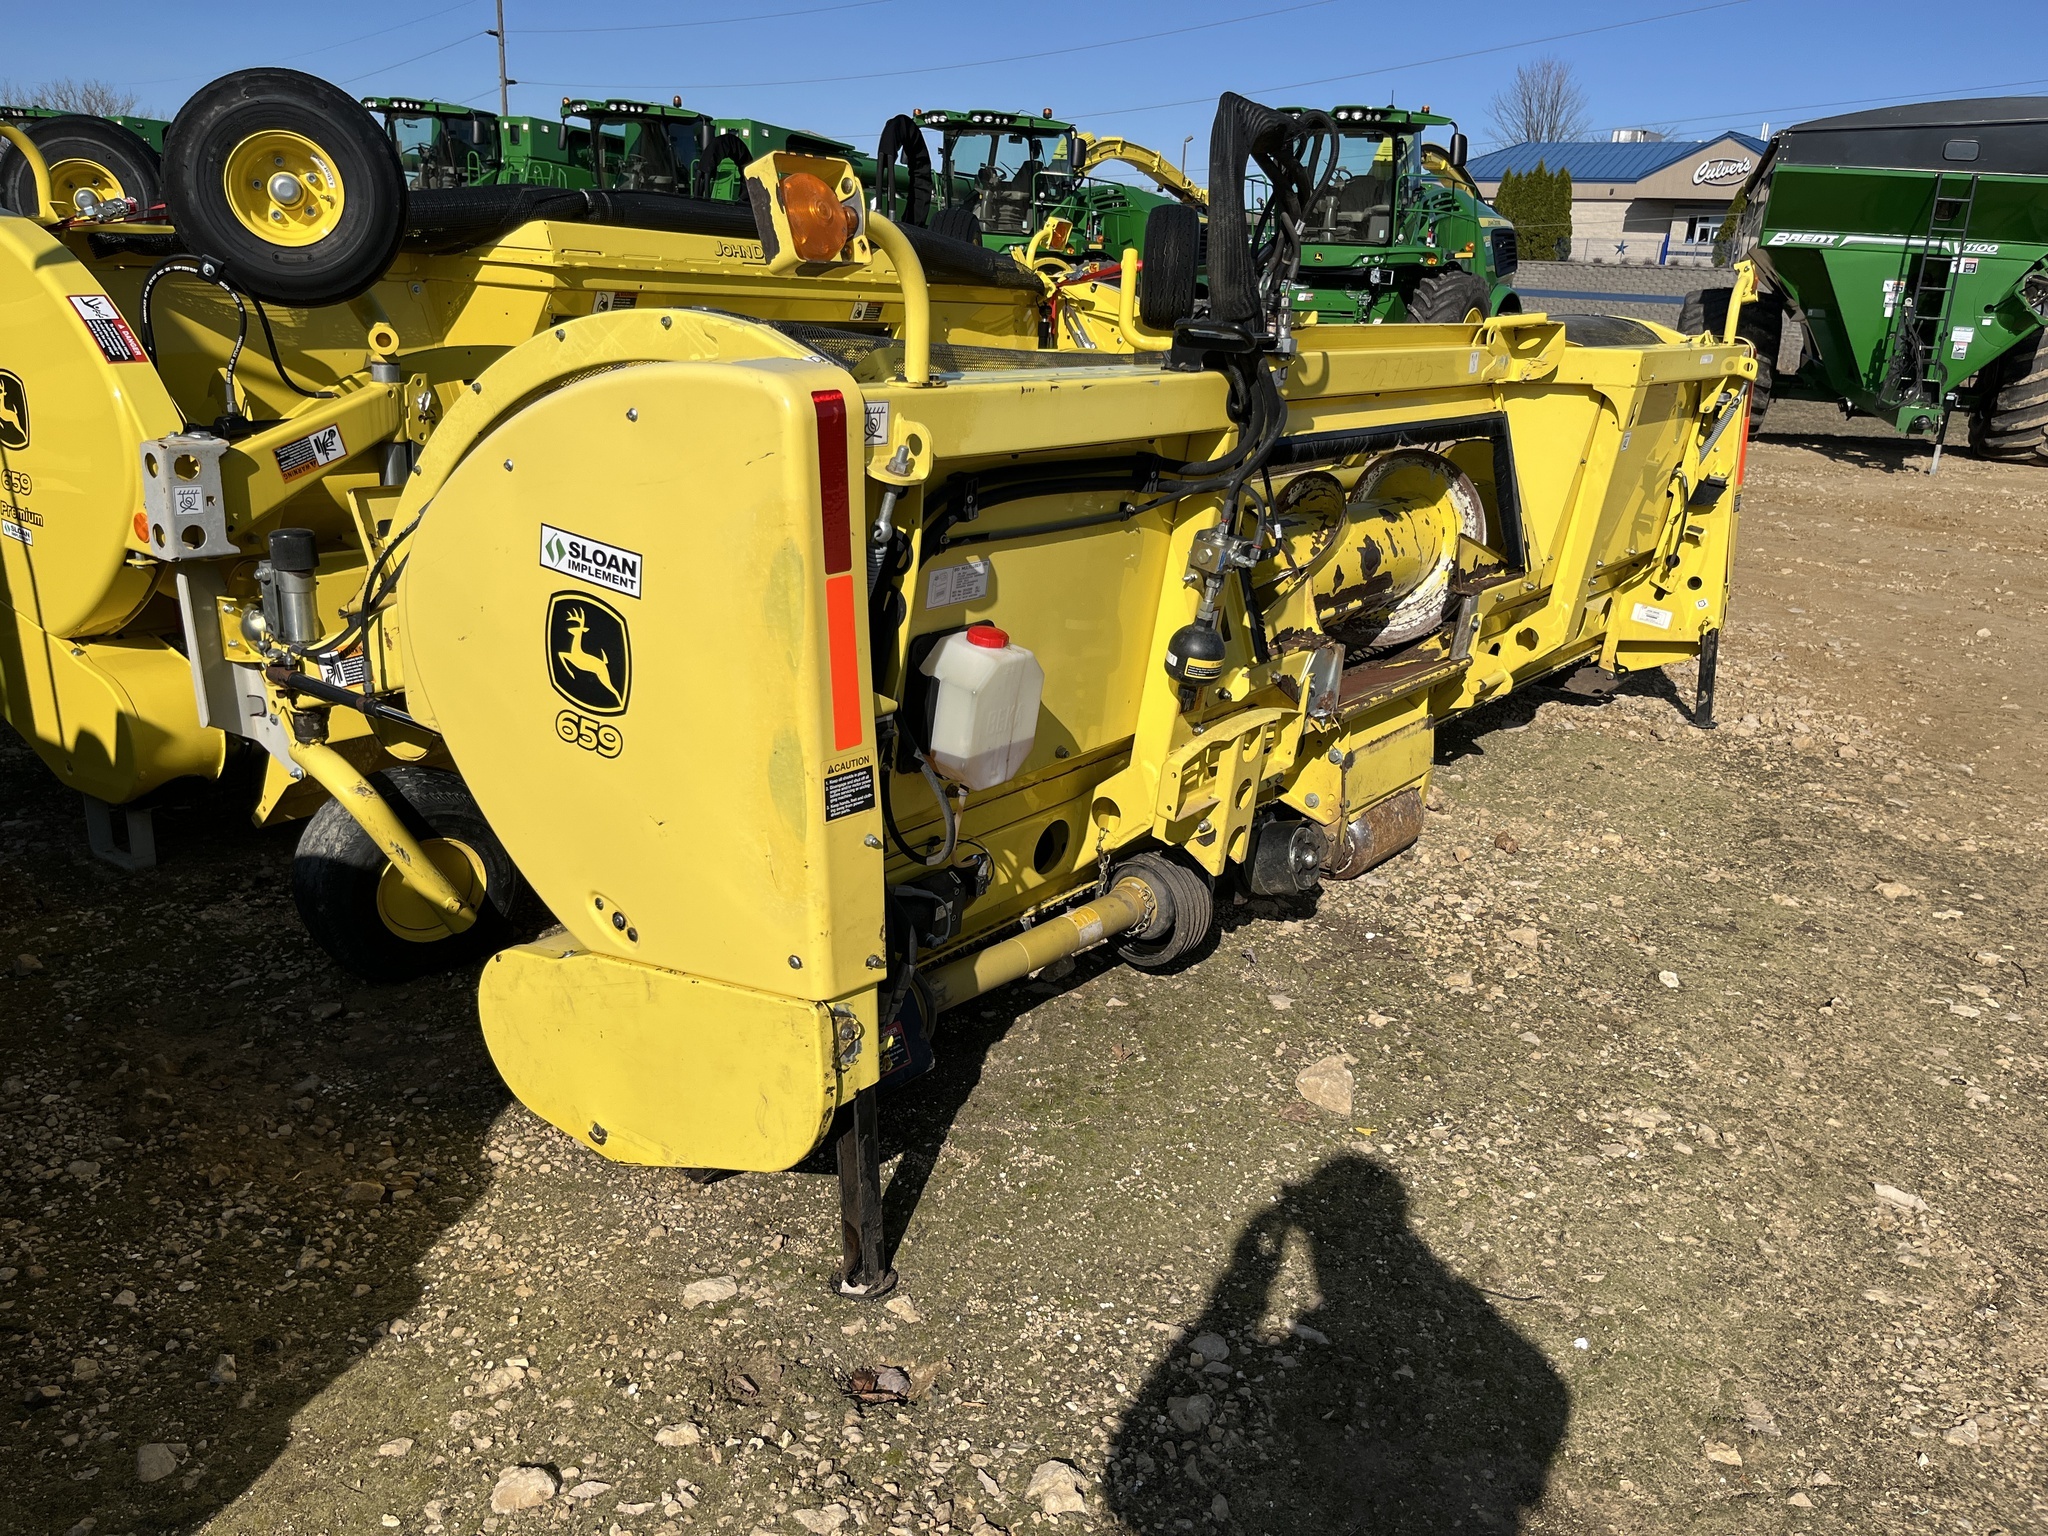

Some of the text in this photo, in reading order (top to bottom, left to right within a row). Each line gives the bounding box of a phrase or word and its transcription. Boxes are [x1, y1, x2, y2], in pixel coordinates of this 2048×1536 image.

[1692, 157, 1751, 185] Culver's
[715, 240, 752, 259] JOHN
[1767, 232, 1840, 247] BRENT
[122, 330, 142, 356] DANGER
[1, 469, 32, 496] 659
[283, 464, 310, 480] WARNING
[1, 500, 43, 527] Premium
[568, 541, 637, 578] SLOAN
[568, 559, 636, 590] IMPLEMENT
[556, 709, 623, 758] 659
[834, 755, 870, 772] CAUTION
